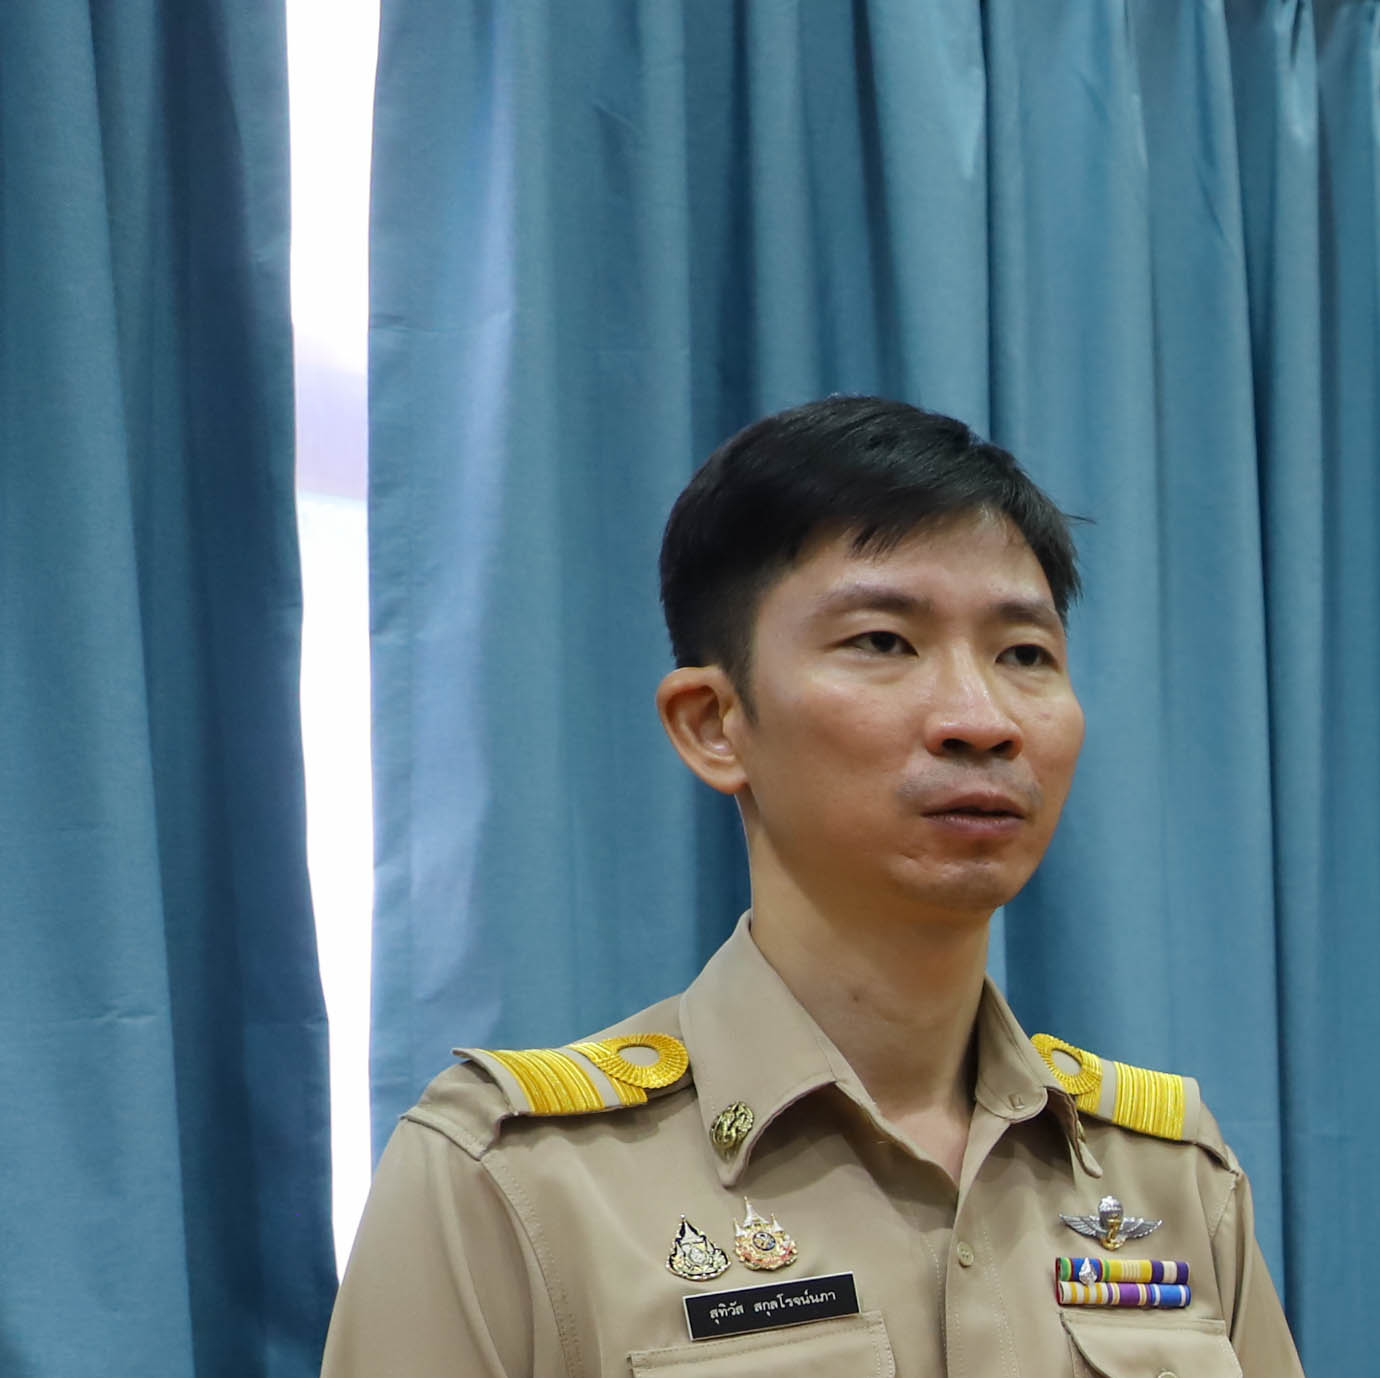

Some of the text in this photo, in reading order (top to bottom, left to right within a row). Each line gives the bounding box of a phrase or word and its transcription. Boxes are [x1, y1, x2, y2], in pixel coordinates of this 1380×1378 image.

[709, 1290, 837, 1325] สุทิวัส สกุลโรจน์นภา
